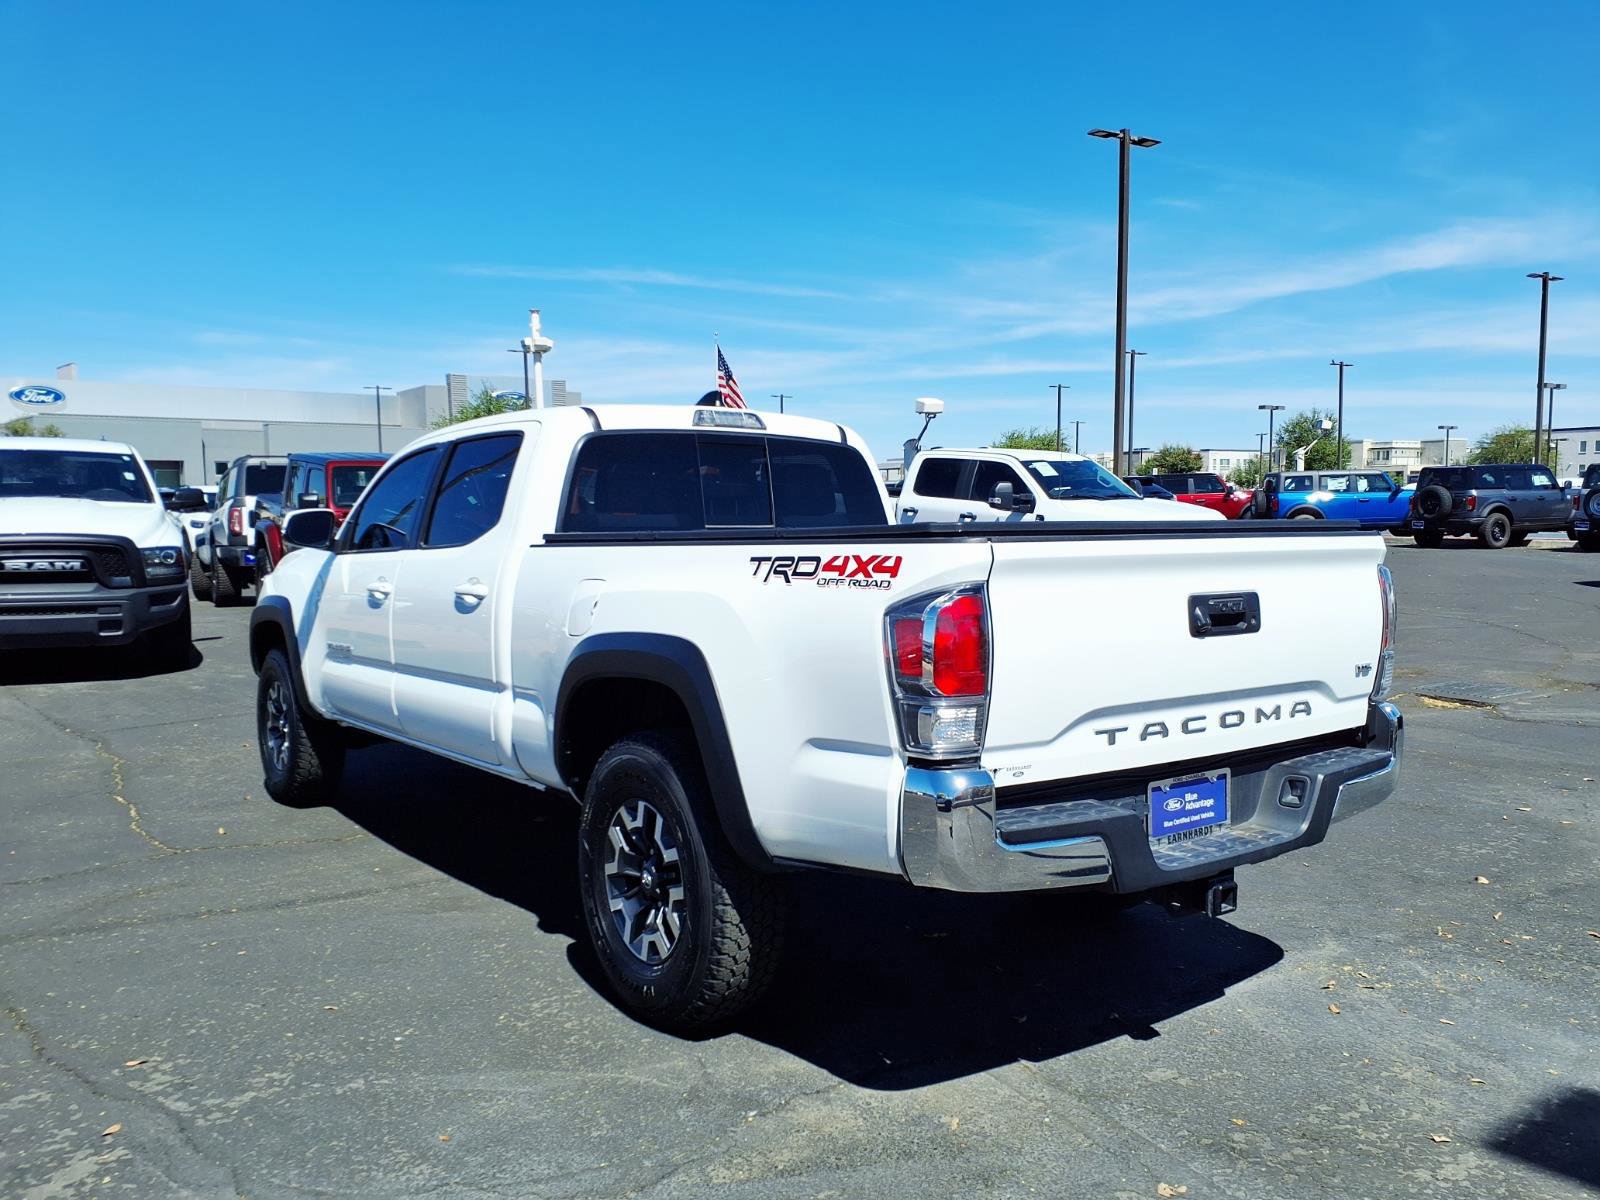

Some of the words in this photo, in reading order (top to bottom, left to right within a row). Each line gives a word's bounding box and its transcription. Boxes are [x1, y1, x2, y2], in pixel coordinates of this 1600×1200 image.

[21, 389, 55, 402] Ford
[3, 561, 81, 571] RAM
[750, 556, 822, 584] TRD
[817, 577, 846, 587] OFF
[847, 578, 892, 590] ROAD
[1094, 701, 1312, 746] TACOMA
[1185, 793, 1198, 801] Blue
[1185, 799, 1214, 810] Advantage
[1168, 825, 1213, 845] EARNHARDT
